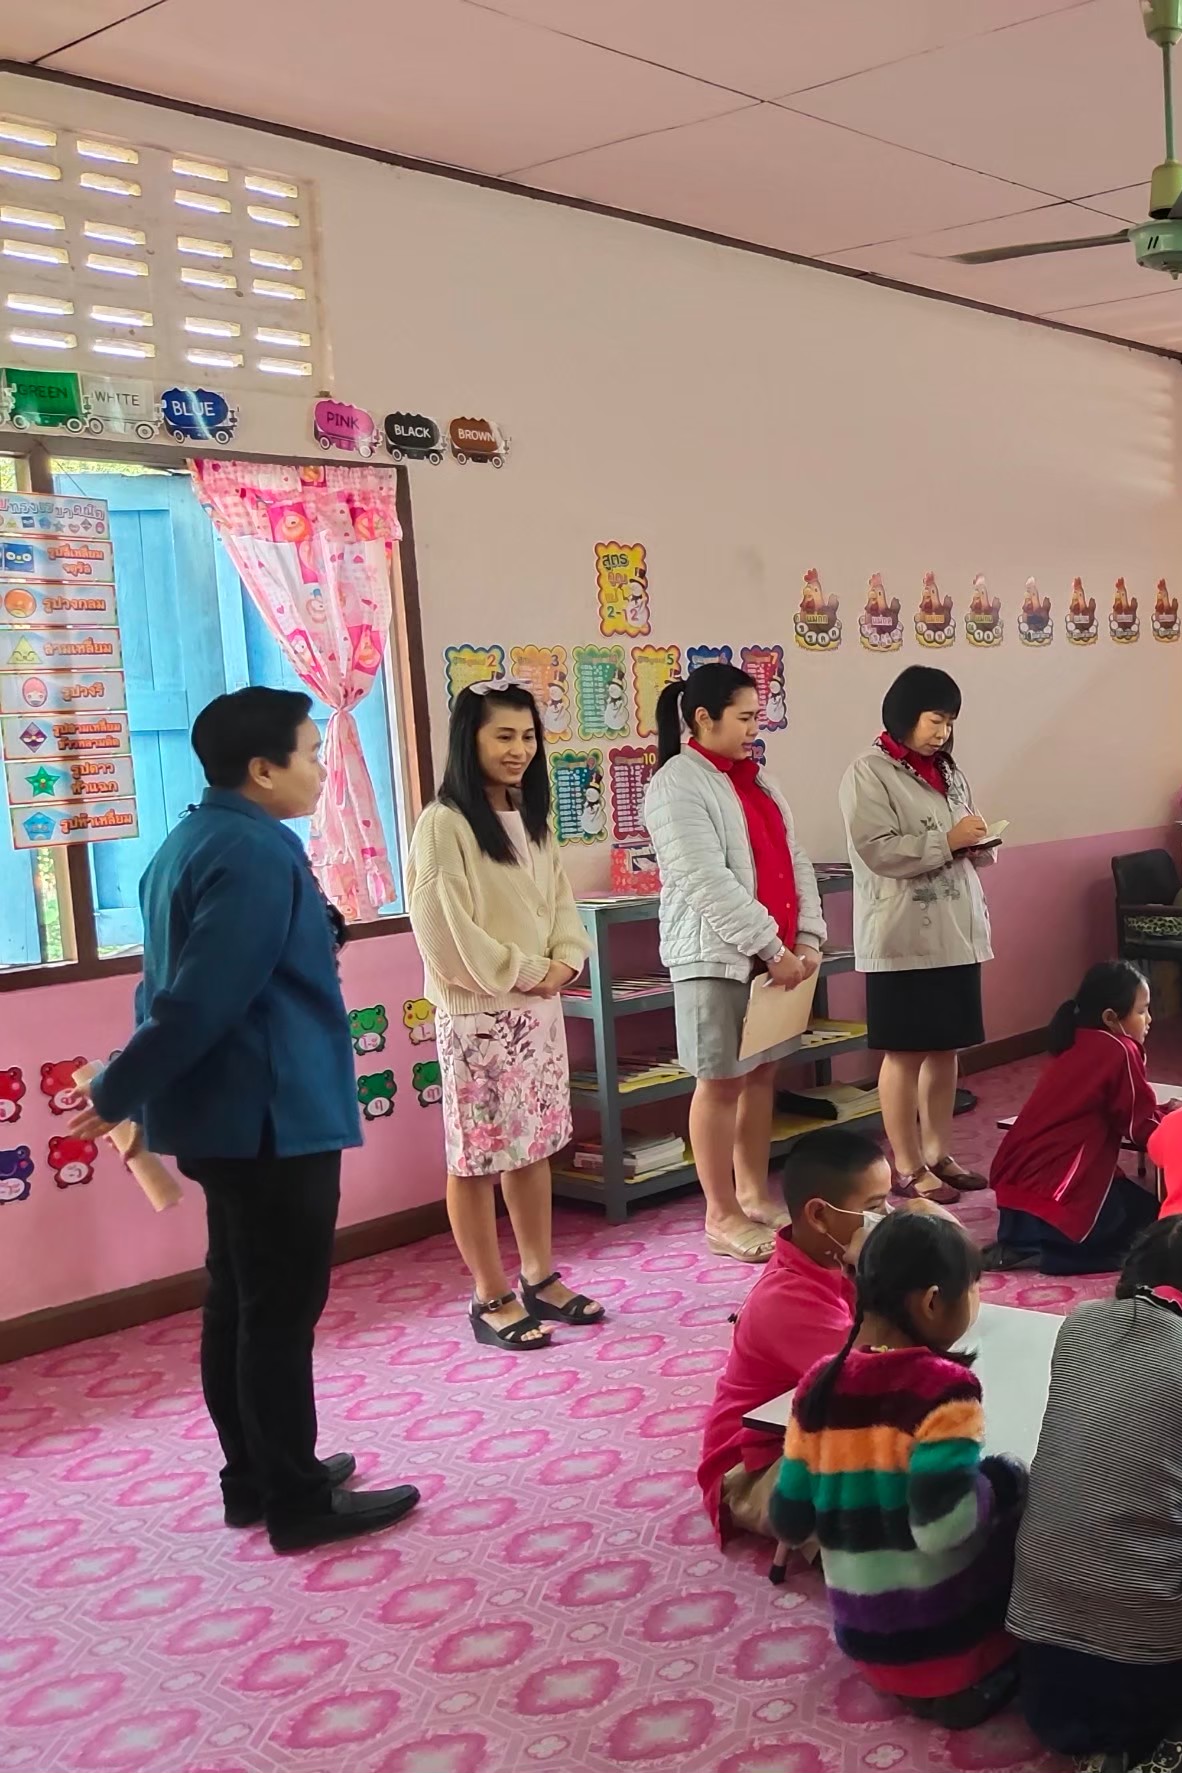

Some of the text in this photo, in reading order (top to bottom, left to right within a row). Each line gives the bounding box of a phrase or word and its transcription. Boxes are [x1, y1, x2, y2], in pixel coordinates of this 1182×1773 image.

[17, 385, 68, 399] GREEN
[94, 390, 141, 407] WHITE
[172, 400, 216, 416] BLUE
[326, 411, 360, 430] PINK
[394, 424, 432, 439] BLACK
[457, 428, 496, 442] BROWN
[602, 553, 629, 571] สูตร
[487, 655, 497, 668] 2
[551, 654, 560, 667] 3
[666, 653, 675, 666] 5
[643, 753, 656, 765] 10
